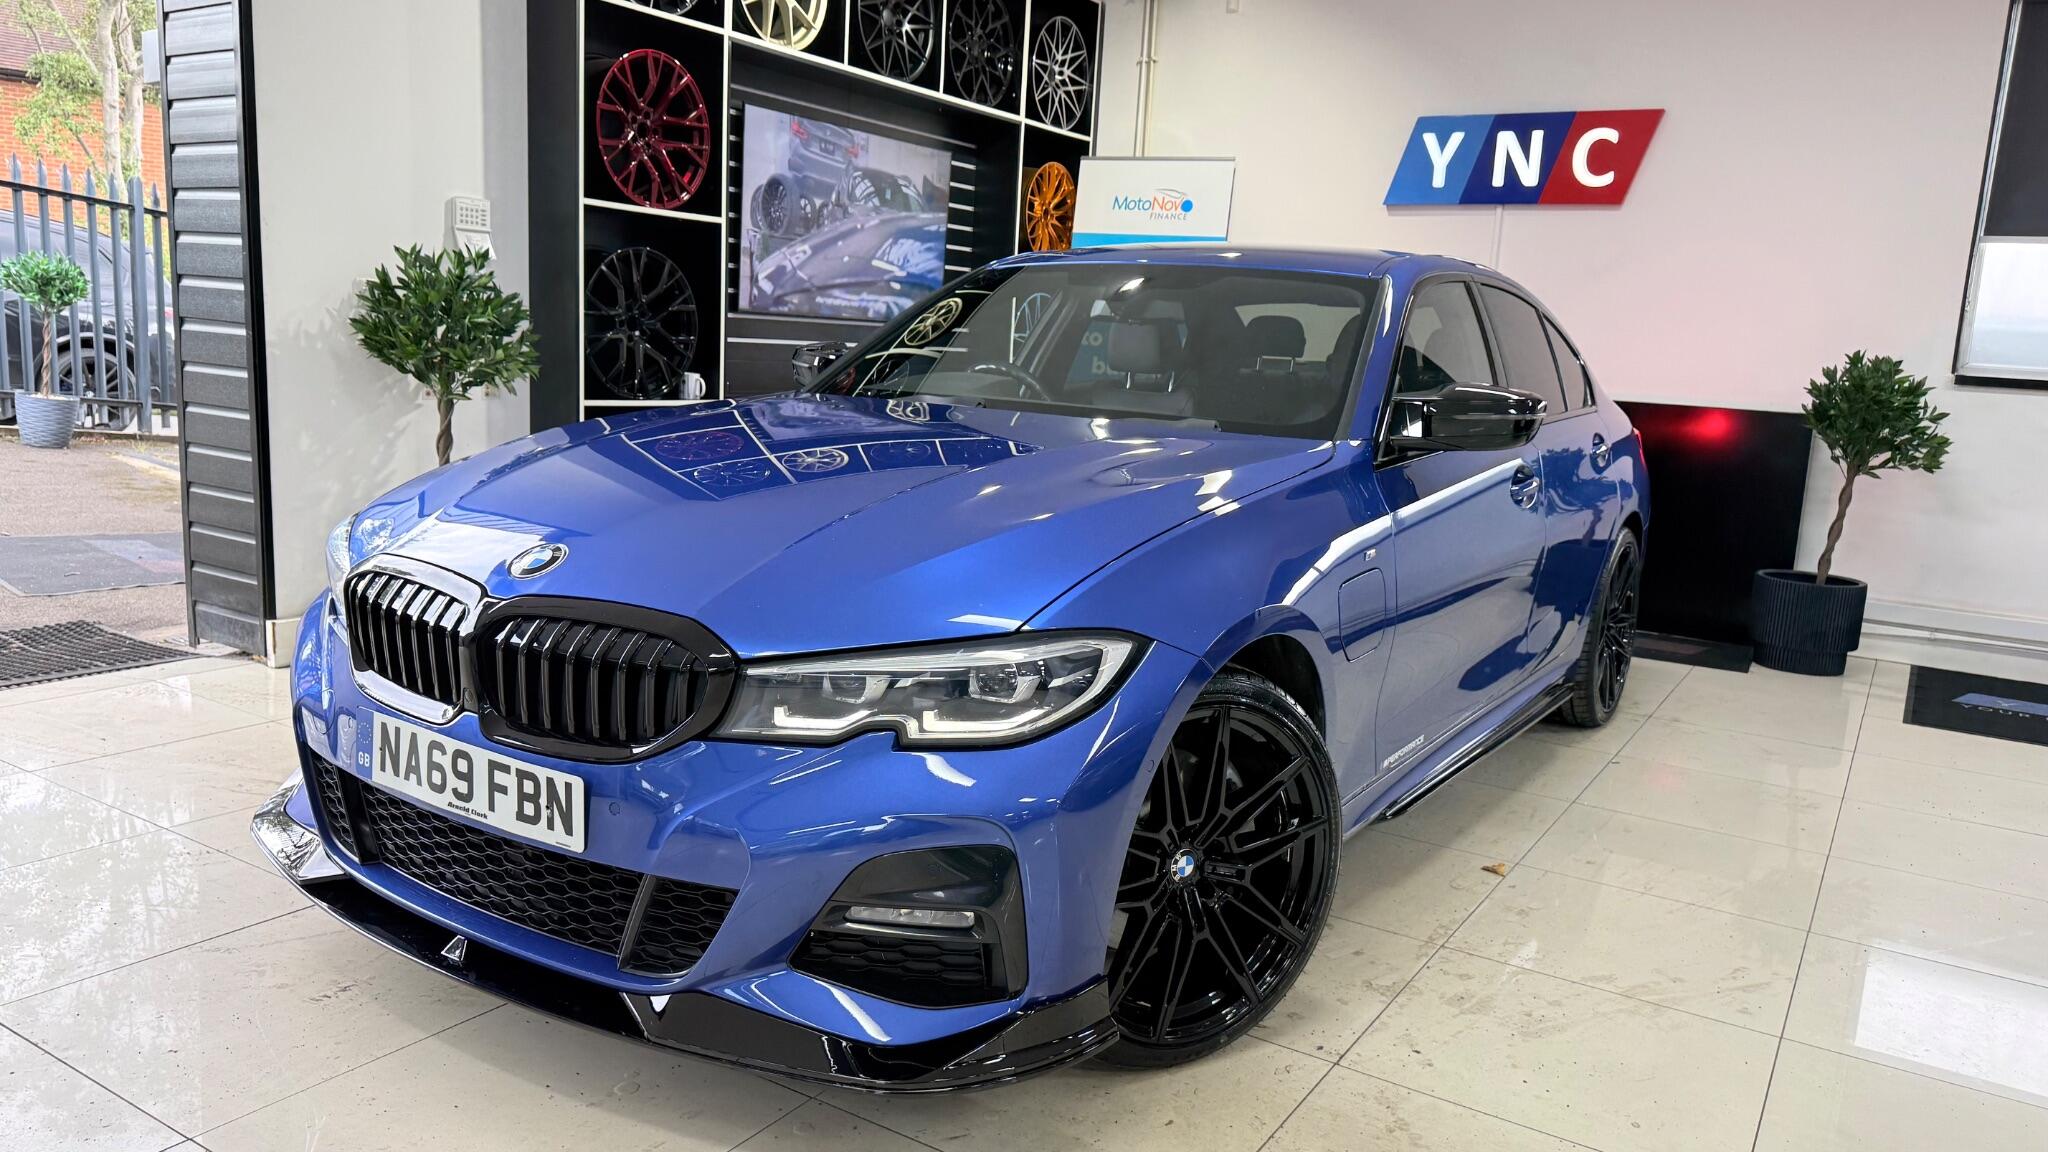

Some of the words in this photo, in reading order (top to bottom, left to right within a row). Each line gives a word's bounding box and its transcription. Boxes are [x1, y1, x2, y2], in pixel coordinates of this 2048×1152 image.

[1422, 126, 1620, 189] YNC
[1149, 212, 1188, 221] FINANCE
[1960, 703, 2030, 717] YOUR
[358, 751, 370, 767] GB
[379, 721, 474, 804] NA69
[487, 758, 574, 837] FBN
[447, 801, 470, 814] Arnold
[471, 808, 488, 820] Clark
